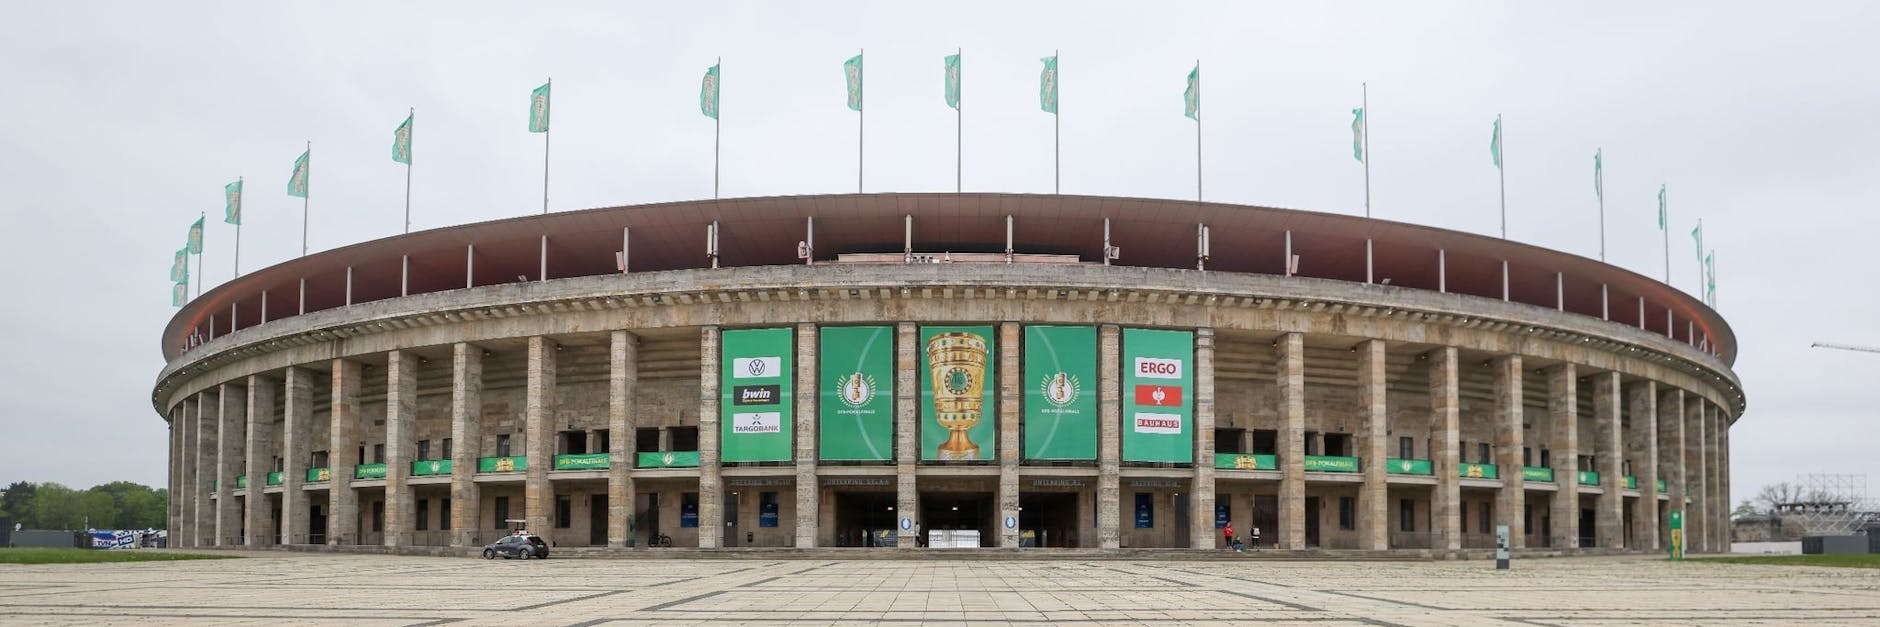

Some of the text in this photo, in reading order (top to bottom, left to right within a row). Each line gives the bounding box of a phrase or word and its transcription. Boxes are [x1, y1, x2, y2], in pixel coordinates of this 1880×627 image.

[1140, 362, 1176, 375] ERGO
[742, 387, 771, 399] bwin
[1137, 418, 1179, 428] BAUHAUS
[735, 425, 779, 433] TARGOBANK
